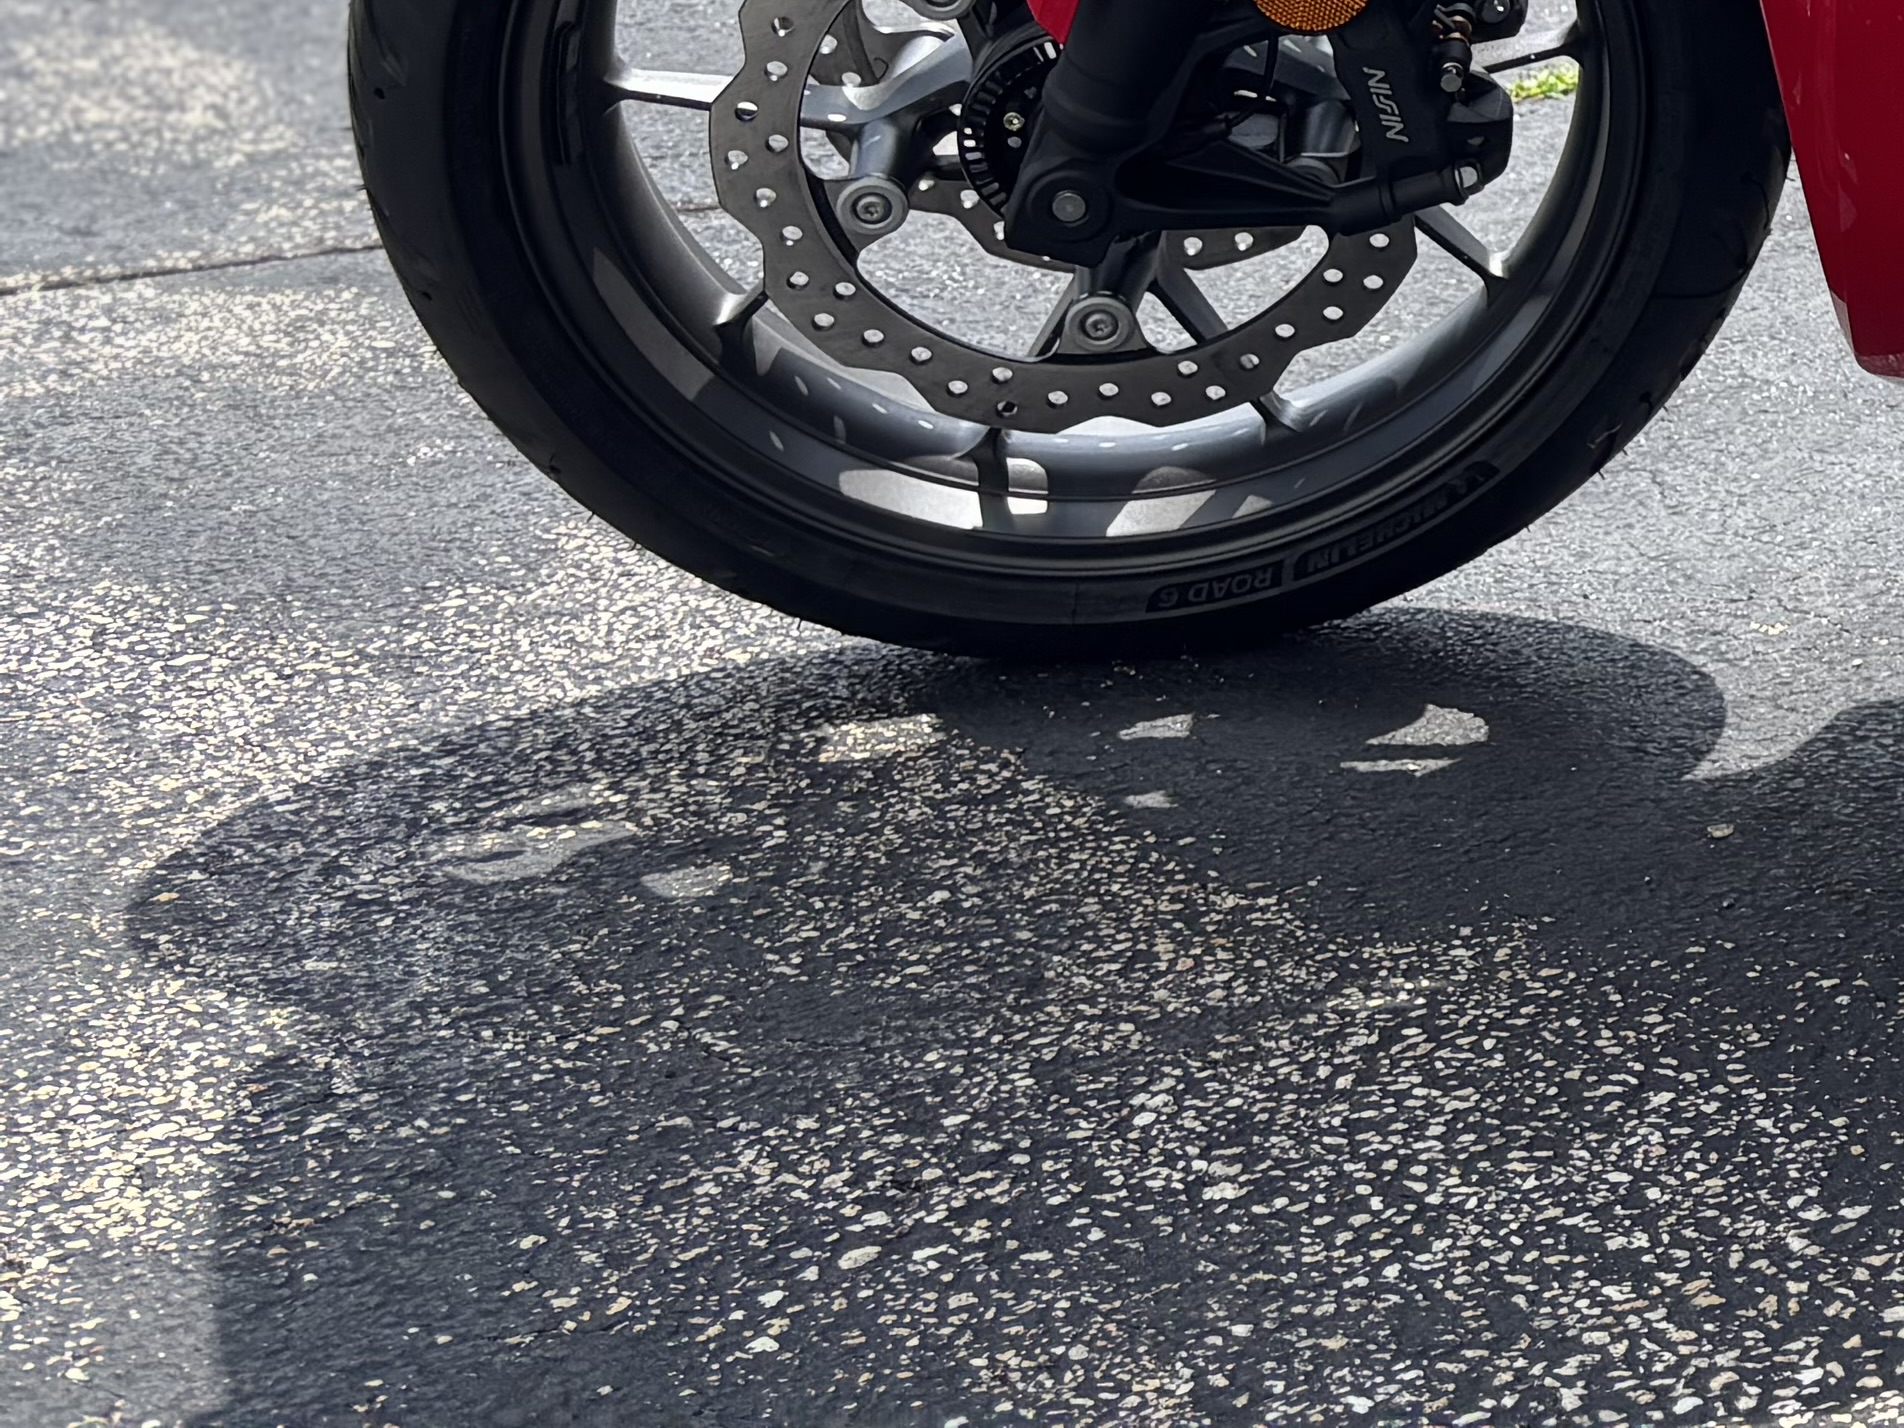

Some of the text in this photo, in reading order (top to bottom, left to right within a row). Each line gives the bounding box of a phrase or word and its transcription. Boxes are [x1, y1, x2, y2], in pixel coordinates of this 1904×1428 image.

[1158, 489, 1449, 608] MICHELIN ROAD 6
